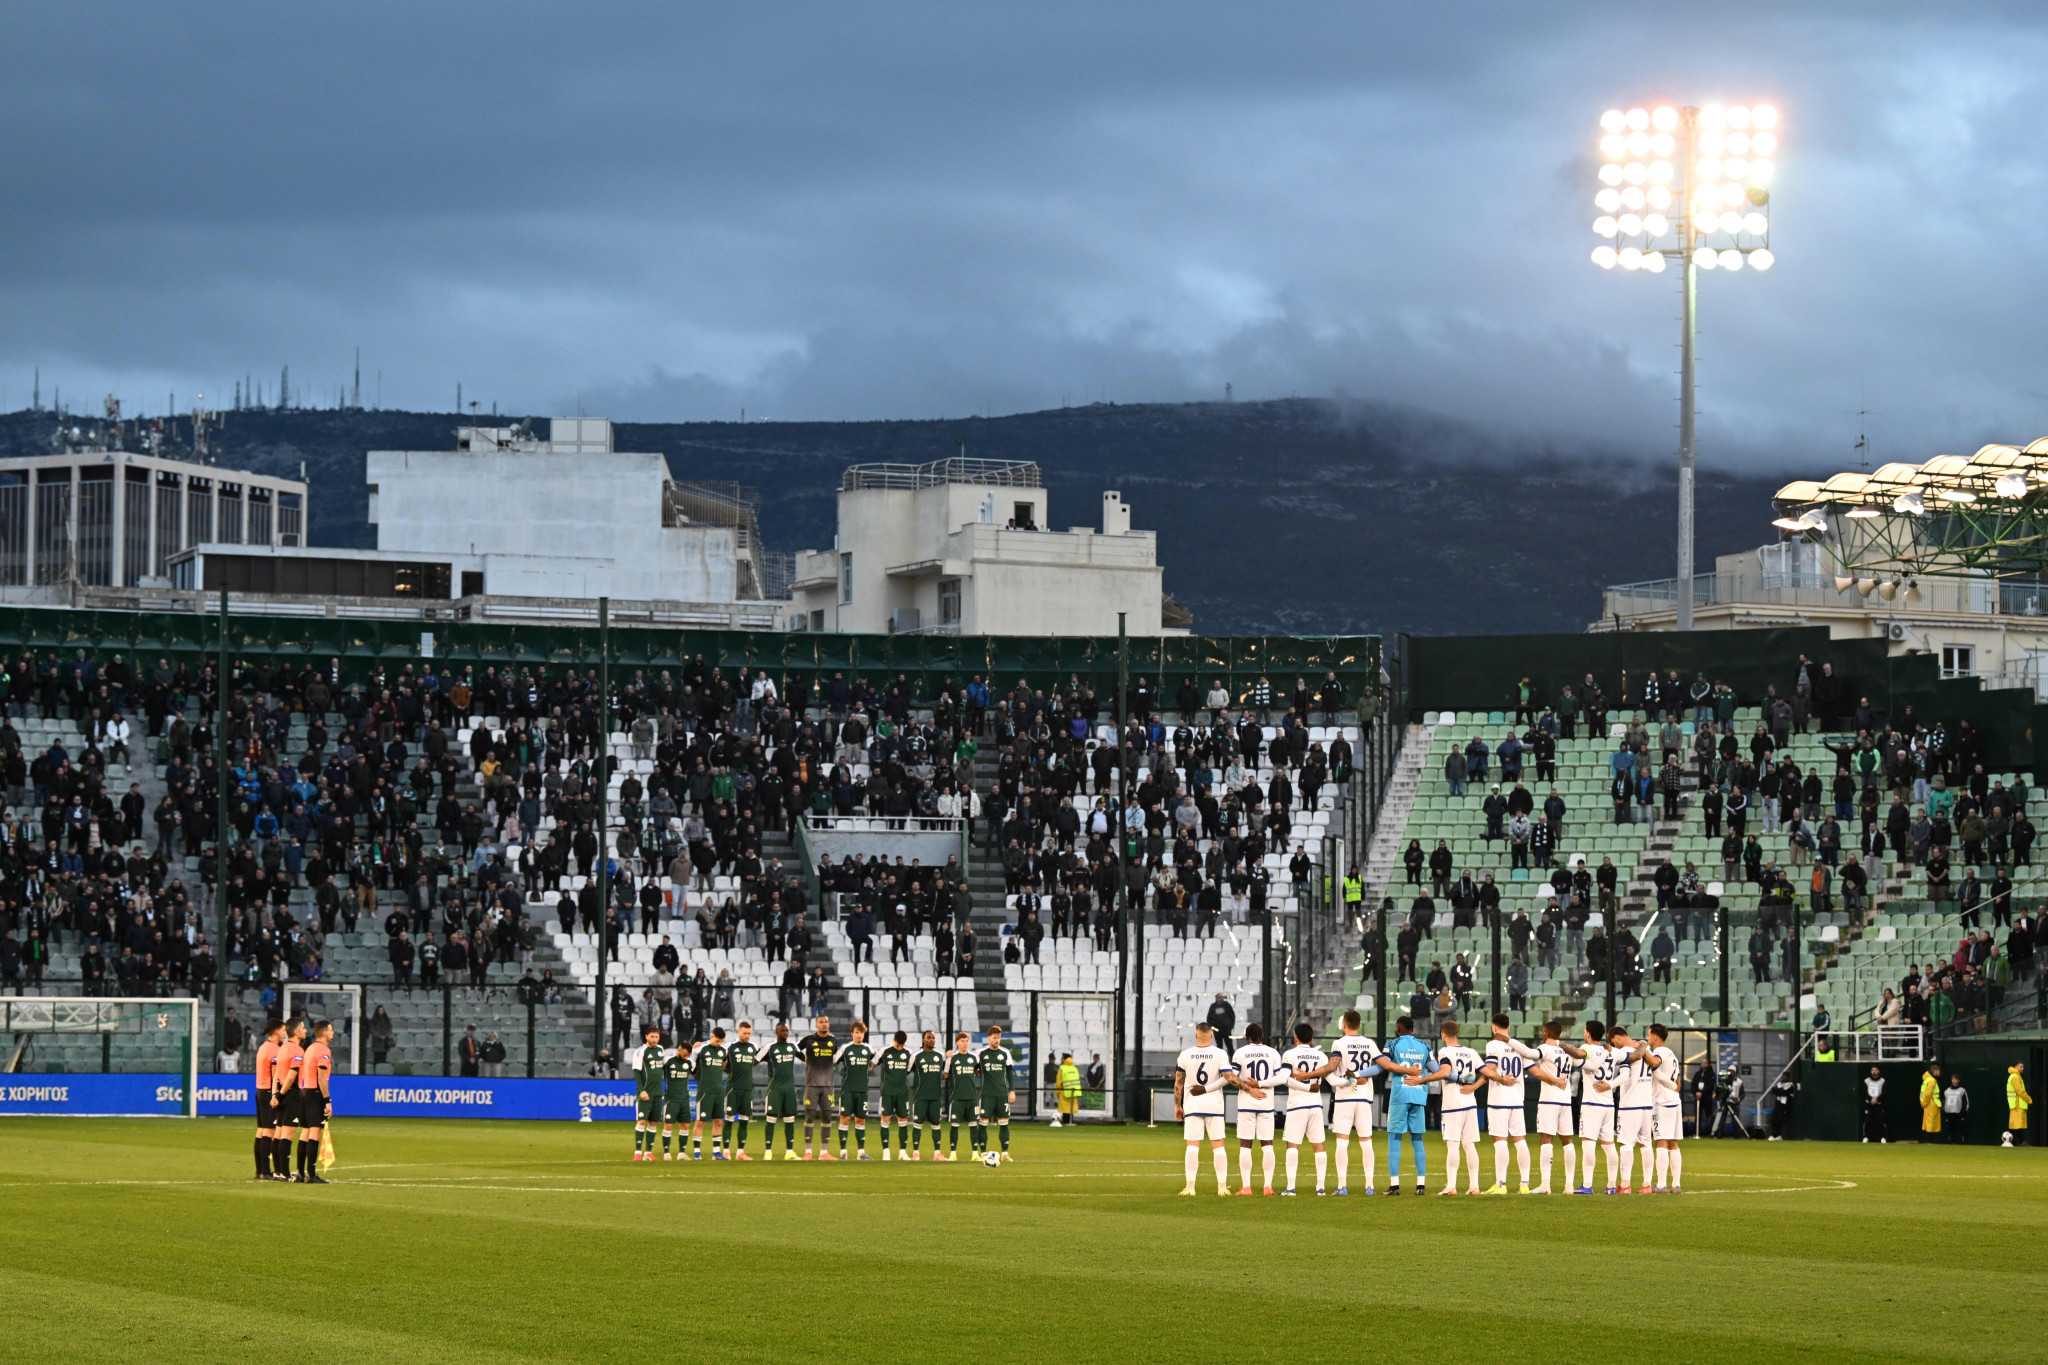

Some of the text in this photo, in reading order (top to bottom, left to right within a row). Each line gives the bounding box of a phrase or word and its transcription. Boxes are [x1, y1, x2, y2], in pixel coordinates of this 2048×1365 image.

[1246, 1059, 1269, 1081] 10
[1348, 1051, 1371, 1072] 38
[1501, 1056, 1522, 1078] 90
[1554, 1056, 1570, 1079] 14
[1671, 1059, 1677, 1081] 2
[1196, 1062, 1208, 1085] 6
[8, 1086, 69, 1101] ΧΟΡΗΓΟΣ
[375, 1088, 493, 1104] ΜΕΓΑΛΟΣ ΧΟΡΗΓΟΣ
